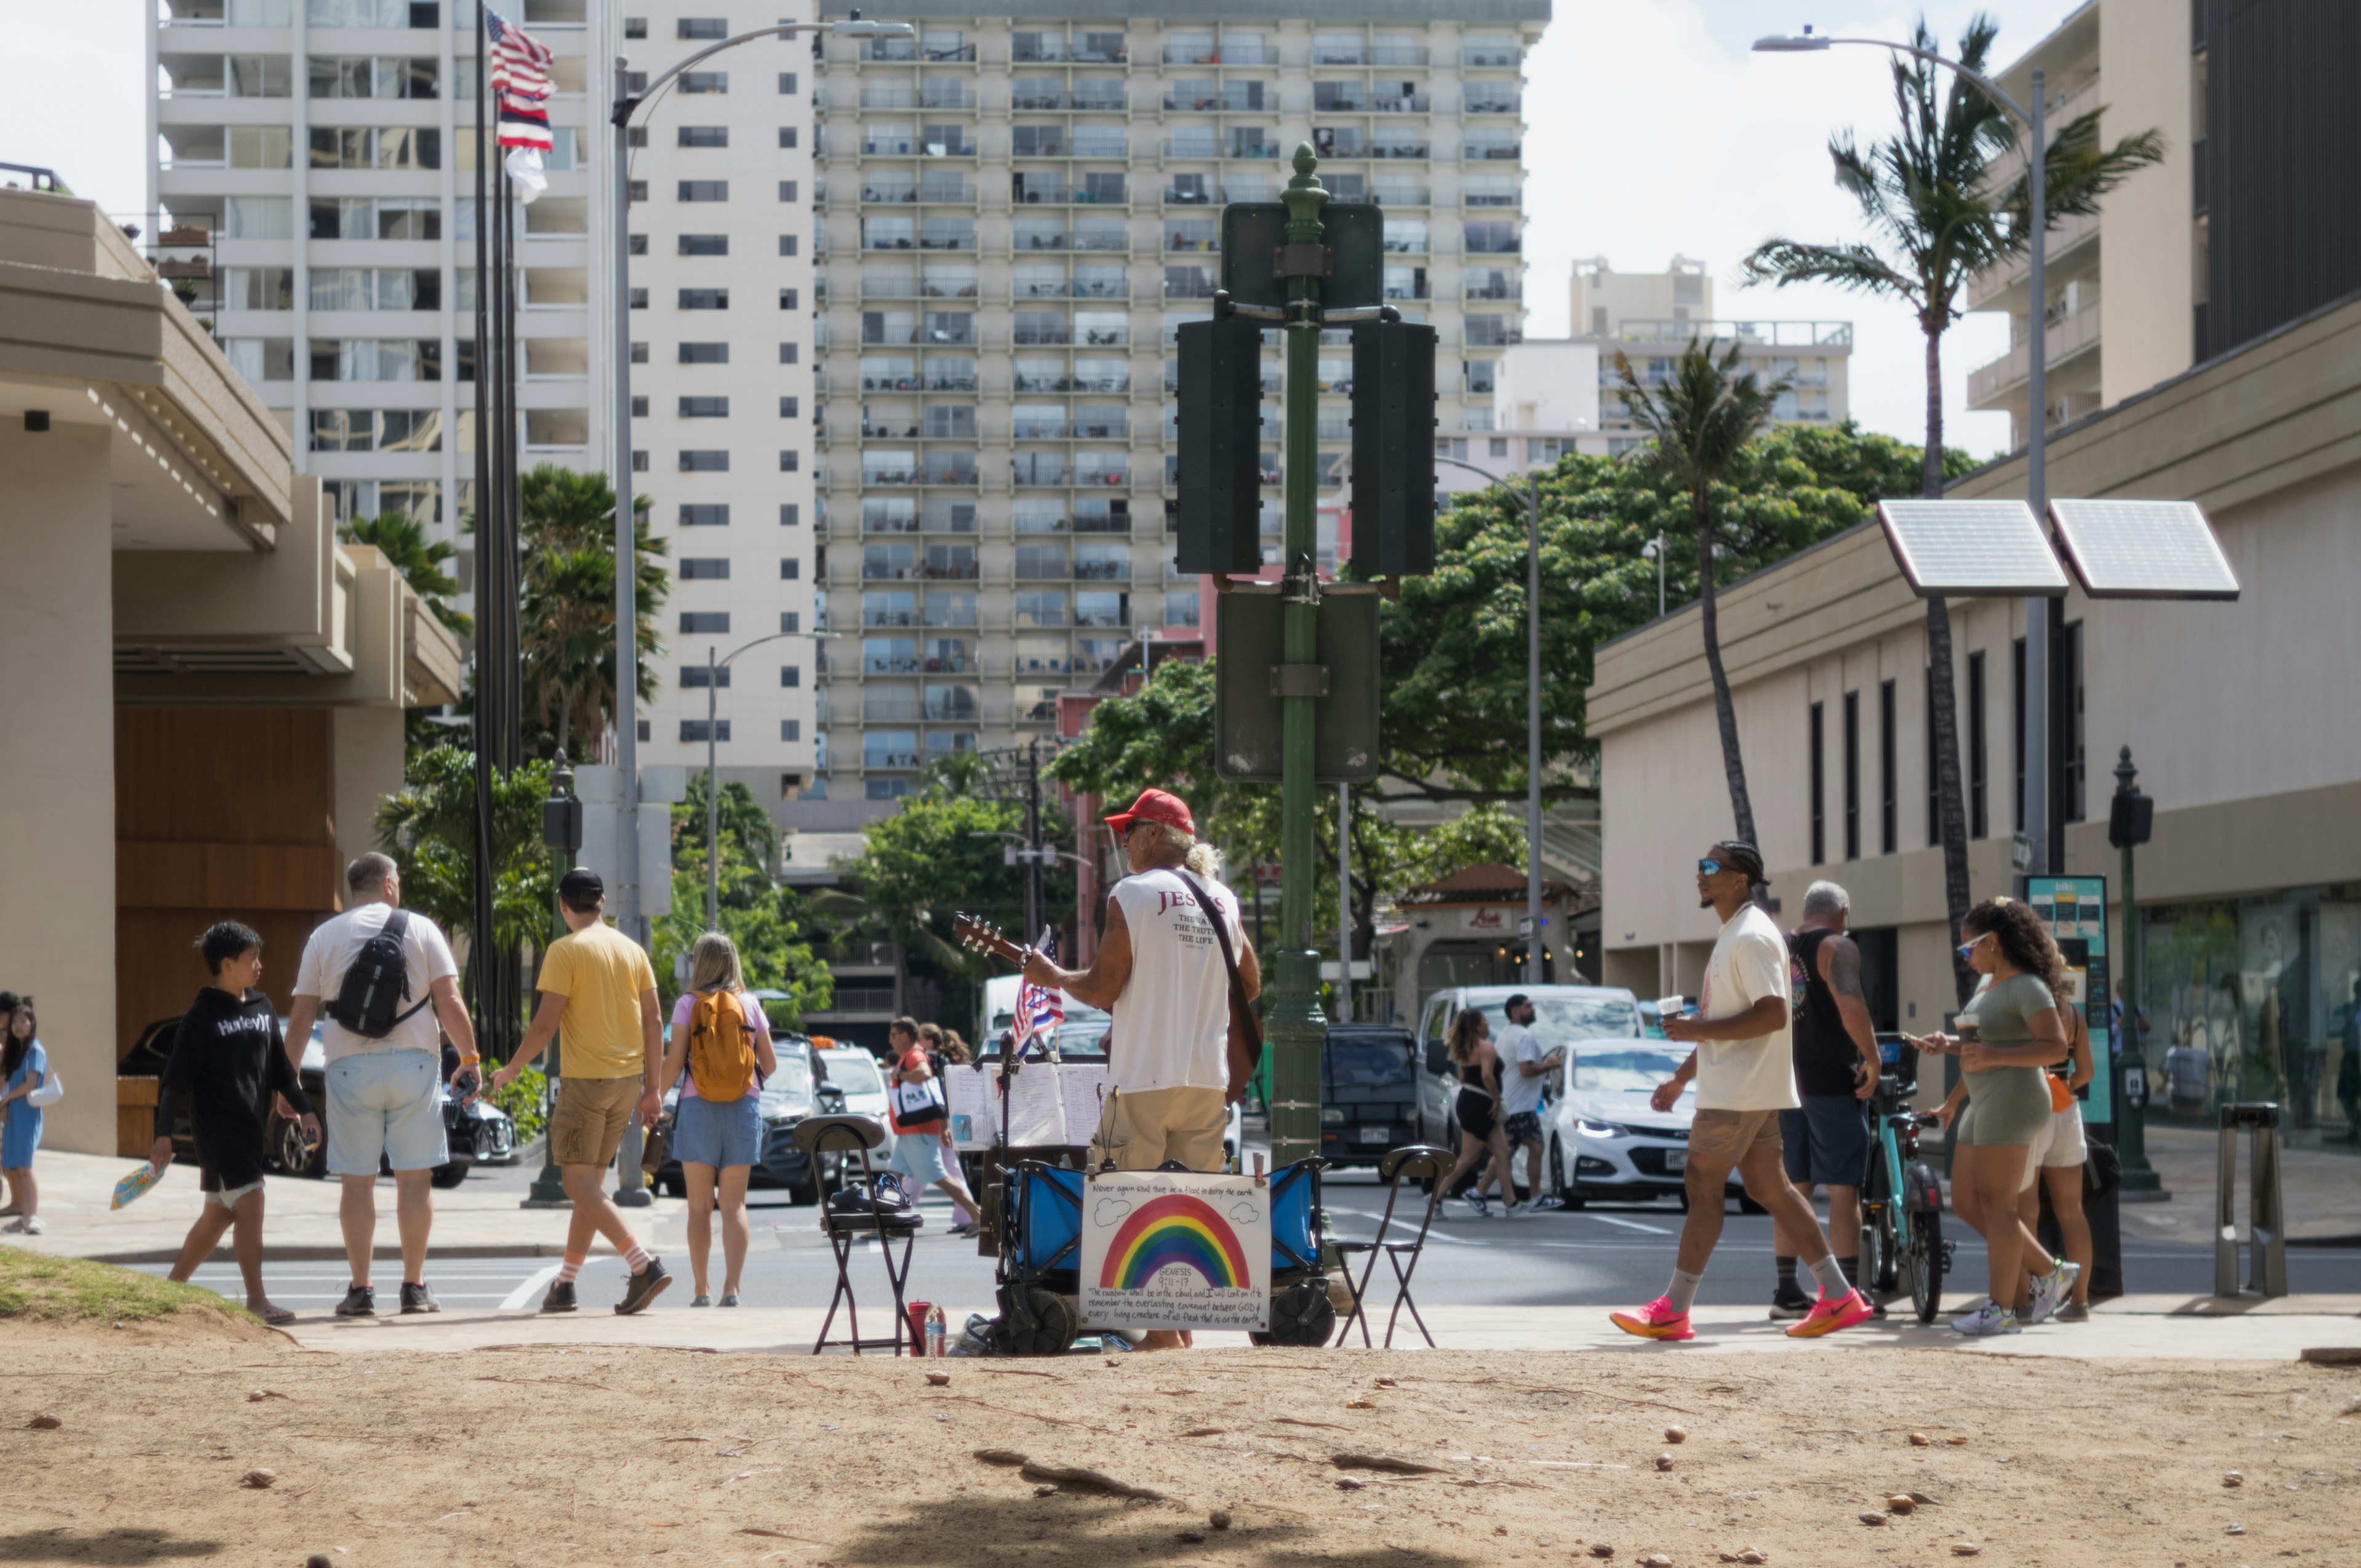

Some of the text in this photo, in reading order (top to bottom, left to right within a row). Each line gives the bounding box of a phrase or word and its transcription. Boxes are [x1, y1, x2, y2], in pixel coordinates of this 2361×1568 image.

[1158, 891, 1225, 916] JESS
[1179, 914, 1194, 923] THE
[1173, 924, 1190, 932] THE
[1179, 934, 1214, 944] THE LIFE
[217, 1015, 260, 1036] Hurley
[1093, 1183, 1114, 1192] Never
[1117, 1184, 1134, 1196] again
[1153, 1185, 1166, 1194] there
[1185, 1186, 1200, 1195] flood
[1208, 1187, 1224, 1200] destroy
[1226, 1187, 1235, 1196] the
[1236, 1187, 1254, 1196] earth.
[1159, 1267, 1192, 1277] GENESIS
[1102, 1288, 1126, 1297] rainbow
[1147, 1288, 1154, 1297] be
[1156, 1288, 1162, 1297] in
[1163, 1286, 1173, 1297] the
[1175, 1288, 1193, 1301] cloud,
[1194, 1288, 1205, 1297] and
[1206, 1288, 1214, 1298] I
[1215, 1288, 1225, 1297] will
[1250, 1285, 1256, 1297] it
[1256, 1287, 1262, 1298] to
[1088, 1298, 1121, 1307] remember
[1123, 1297, 1133, 1307] the
[1136, 1298, 1174, 1313] everlasting
[1178, 1300, 1210, 1310] covenant
[1212, 1302, 1236, 1312] between
[1238, 1303, 1254, 1312] GOD
[1088, 1310, 1109, 1321] every
[1114, 1309, 1131, 1322] living
[1132, 1309, 1160, 1320] creature
[1163, 1310, 1172, 1320] of
[1183, 1312, 1199, 1322] flesh
[1200, 1313, 1212, 1323] that
[1214, 1315, 1221, 1323] is
[1230, 1313, 1240, 1323] the
